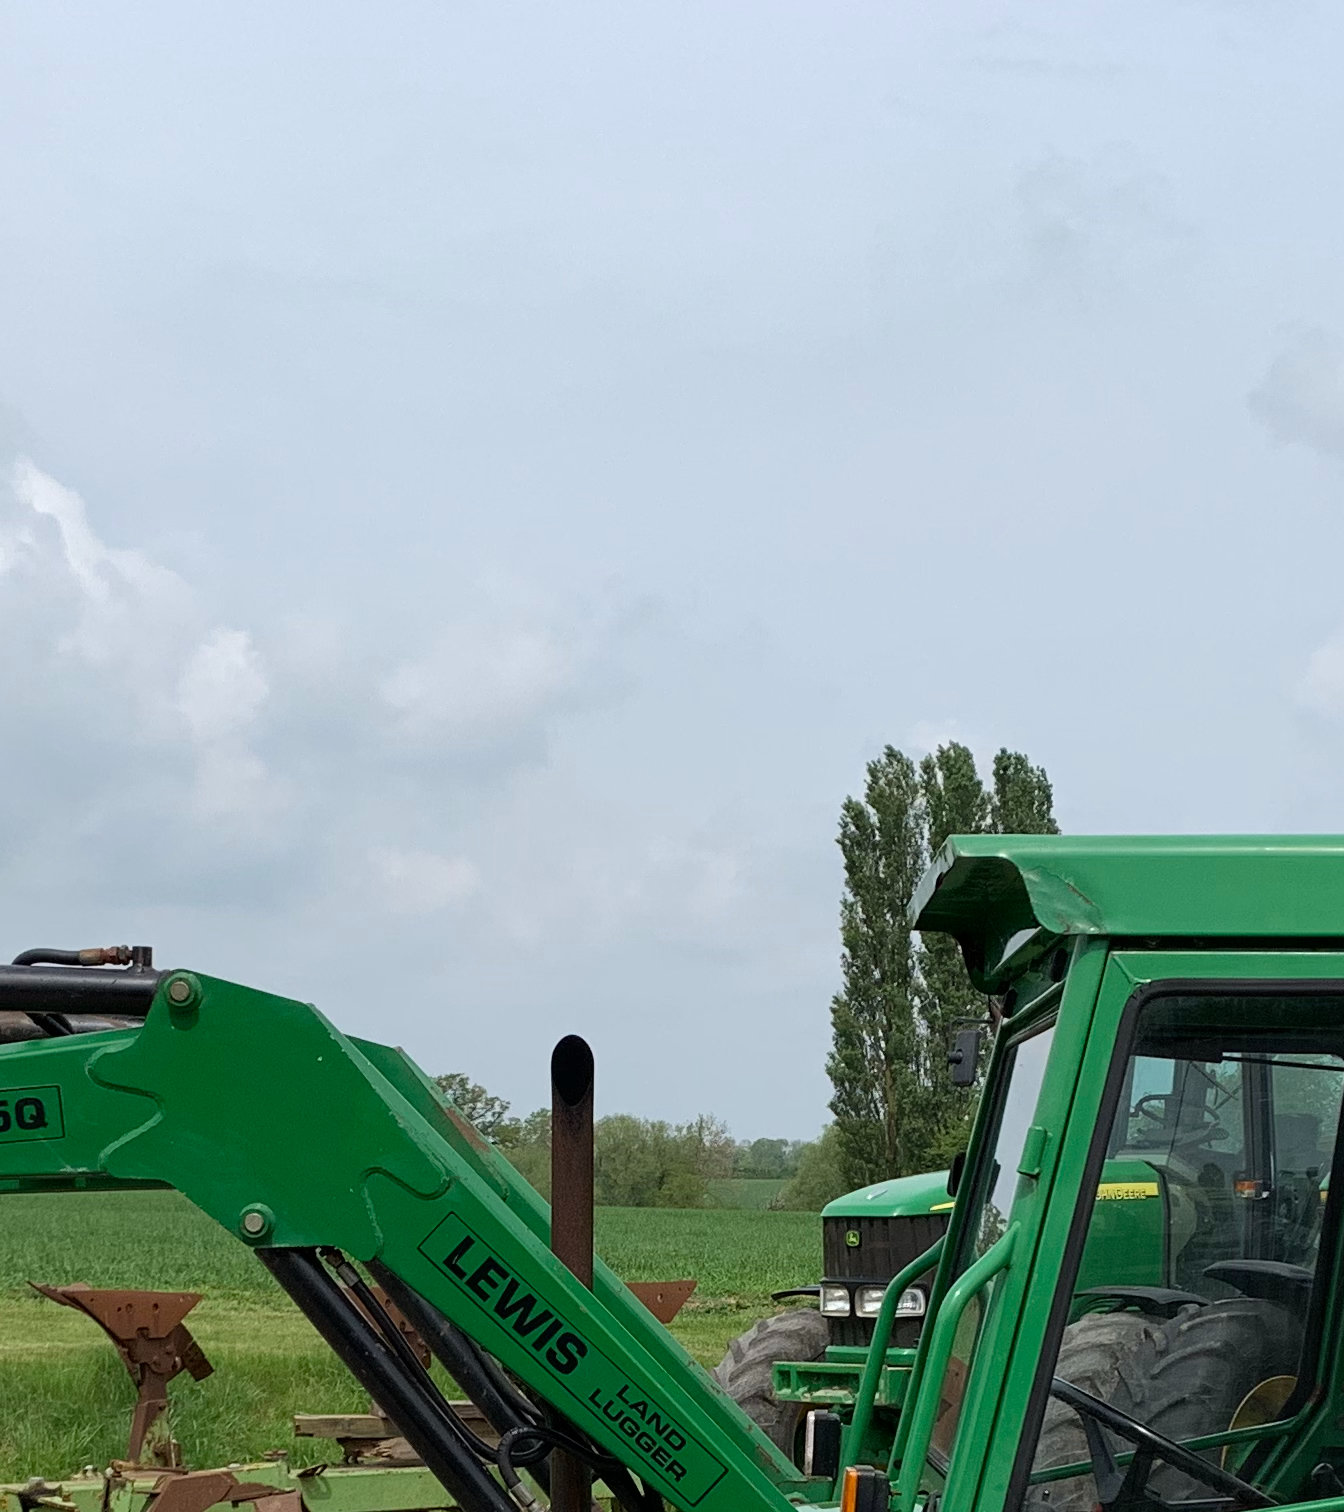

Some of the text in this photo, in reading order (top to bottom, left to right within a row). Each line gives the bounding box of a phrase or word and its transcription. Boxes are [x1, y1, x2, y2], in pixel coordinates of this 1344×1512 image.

[442, 1235, 589, 1375] LEWIS
[588, 1388, 687, 1483] LUGGER
[615, 1384, 687, 1452] LAND
